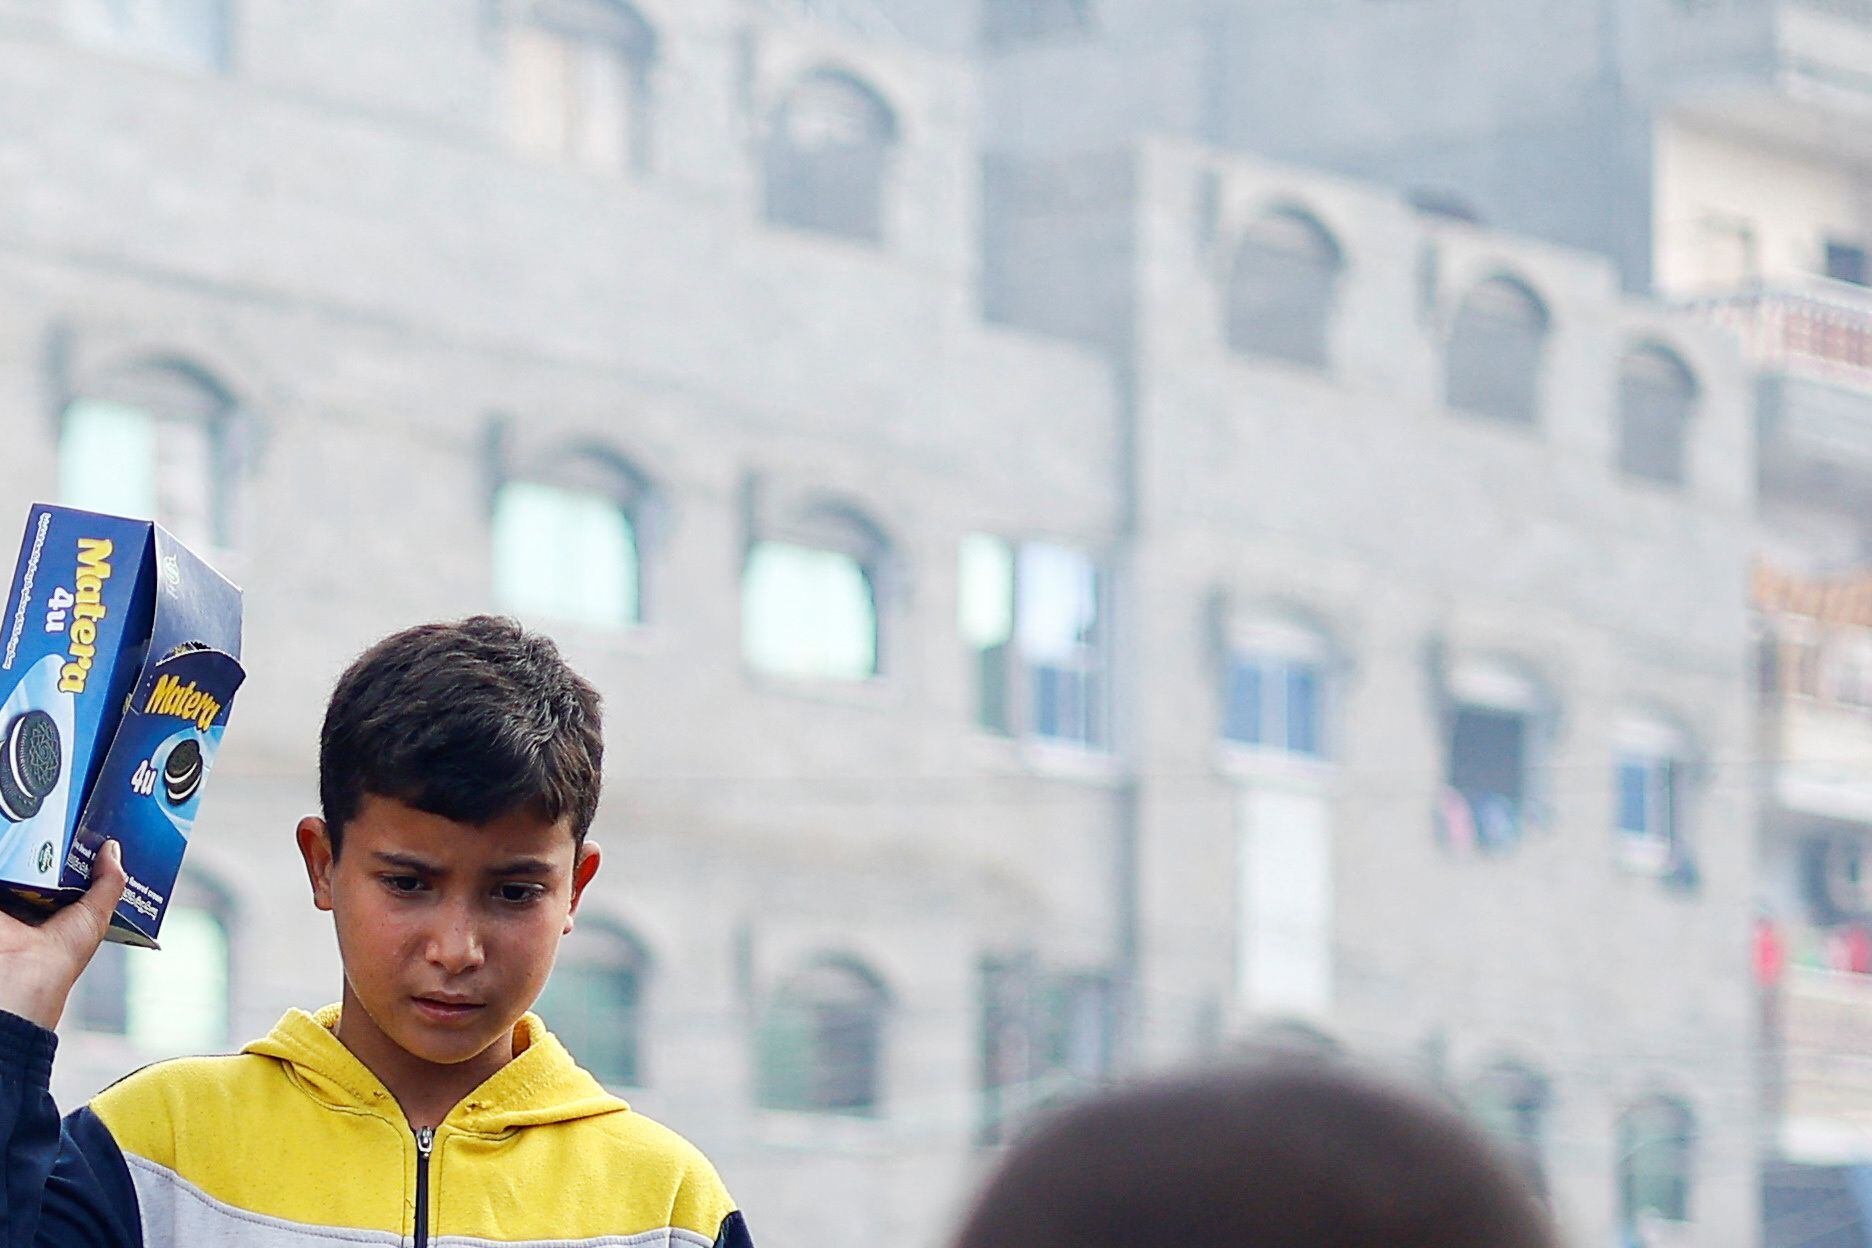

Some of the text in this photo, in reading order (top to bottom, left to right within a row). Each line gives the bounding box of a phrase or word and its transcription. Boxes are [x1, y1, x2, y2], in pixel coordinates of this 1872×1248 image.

[45, 587, 74, 633] 4u
[57, 538, 114, 694] Matera
[144, 674, 221, 732] Matera
[130, 759, 157, 796] 4u
